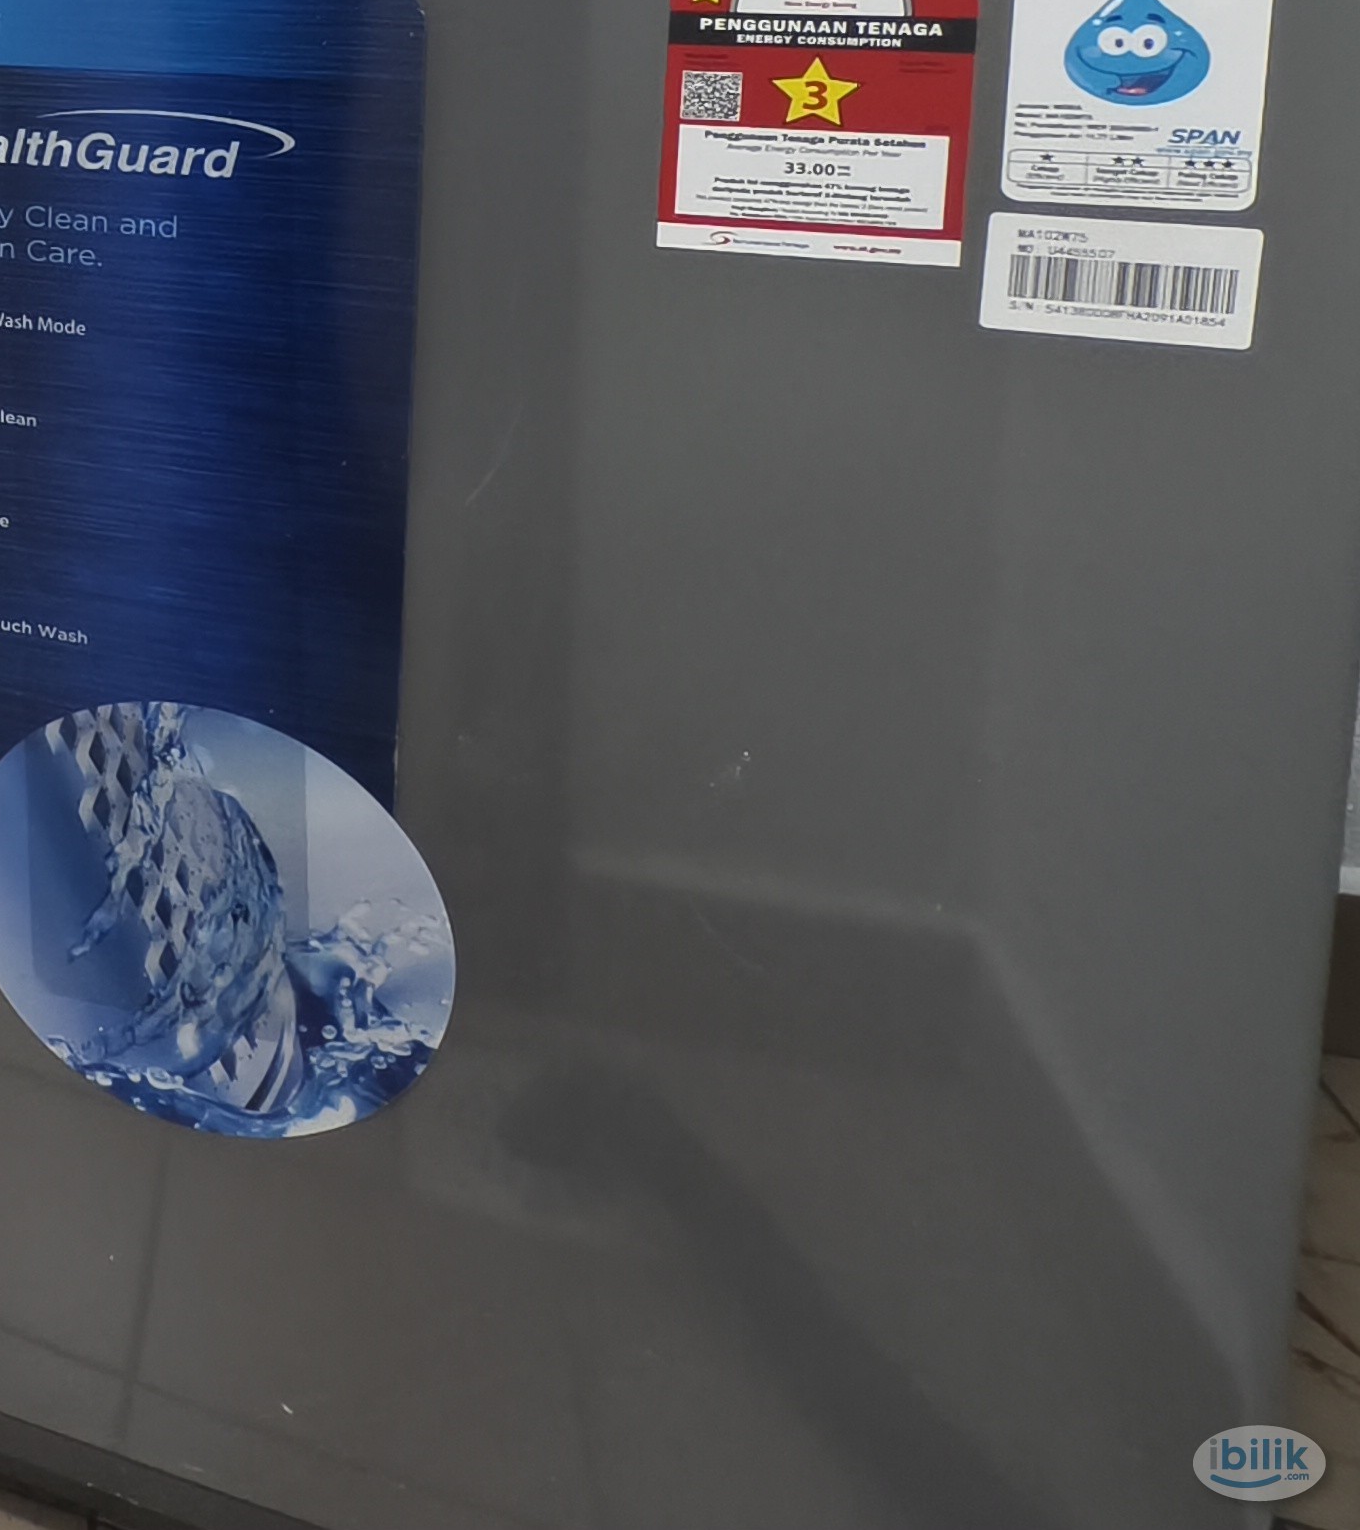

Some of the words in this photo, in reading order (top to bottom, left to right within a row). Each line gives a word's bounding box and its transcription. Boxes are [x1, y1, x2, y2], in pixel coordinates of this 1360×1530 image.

[700, 17, 847, 34] PENGGUNAAN
[856, 21, 943, 37] TENAGA
[737, 34, 791, 45] ENERGY
[797, 36, 901, 48] CONSUMPTION
[802, 81, 827, 110] 3
[1167, 128, 1241, 145] SPAN
[784, 161, 835, 176] 33.00
[25, 206, 108, 234] Clean
[119, 214, 178, 239] and
[26, 239, 103, 267] Care.
[37, 317, 86, 336] Mode
[37, 624, 88, 645] Wash
